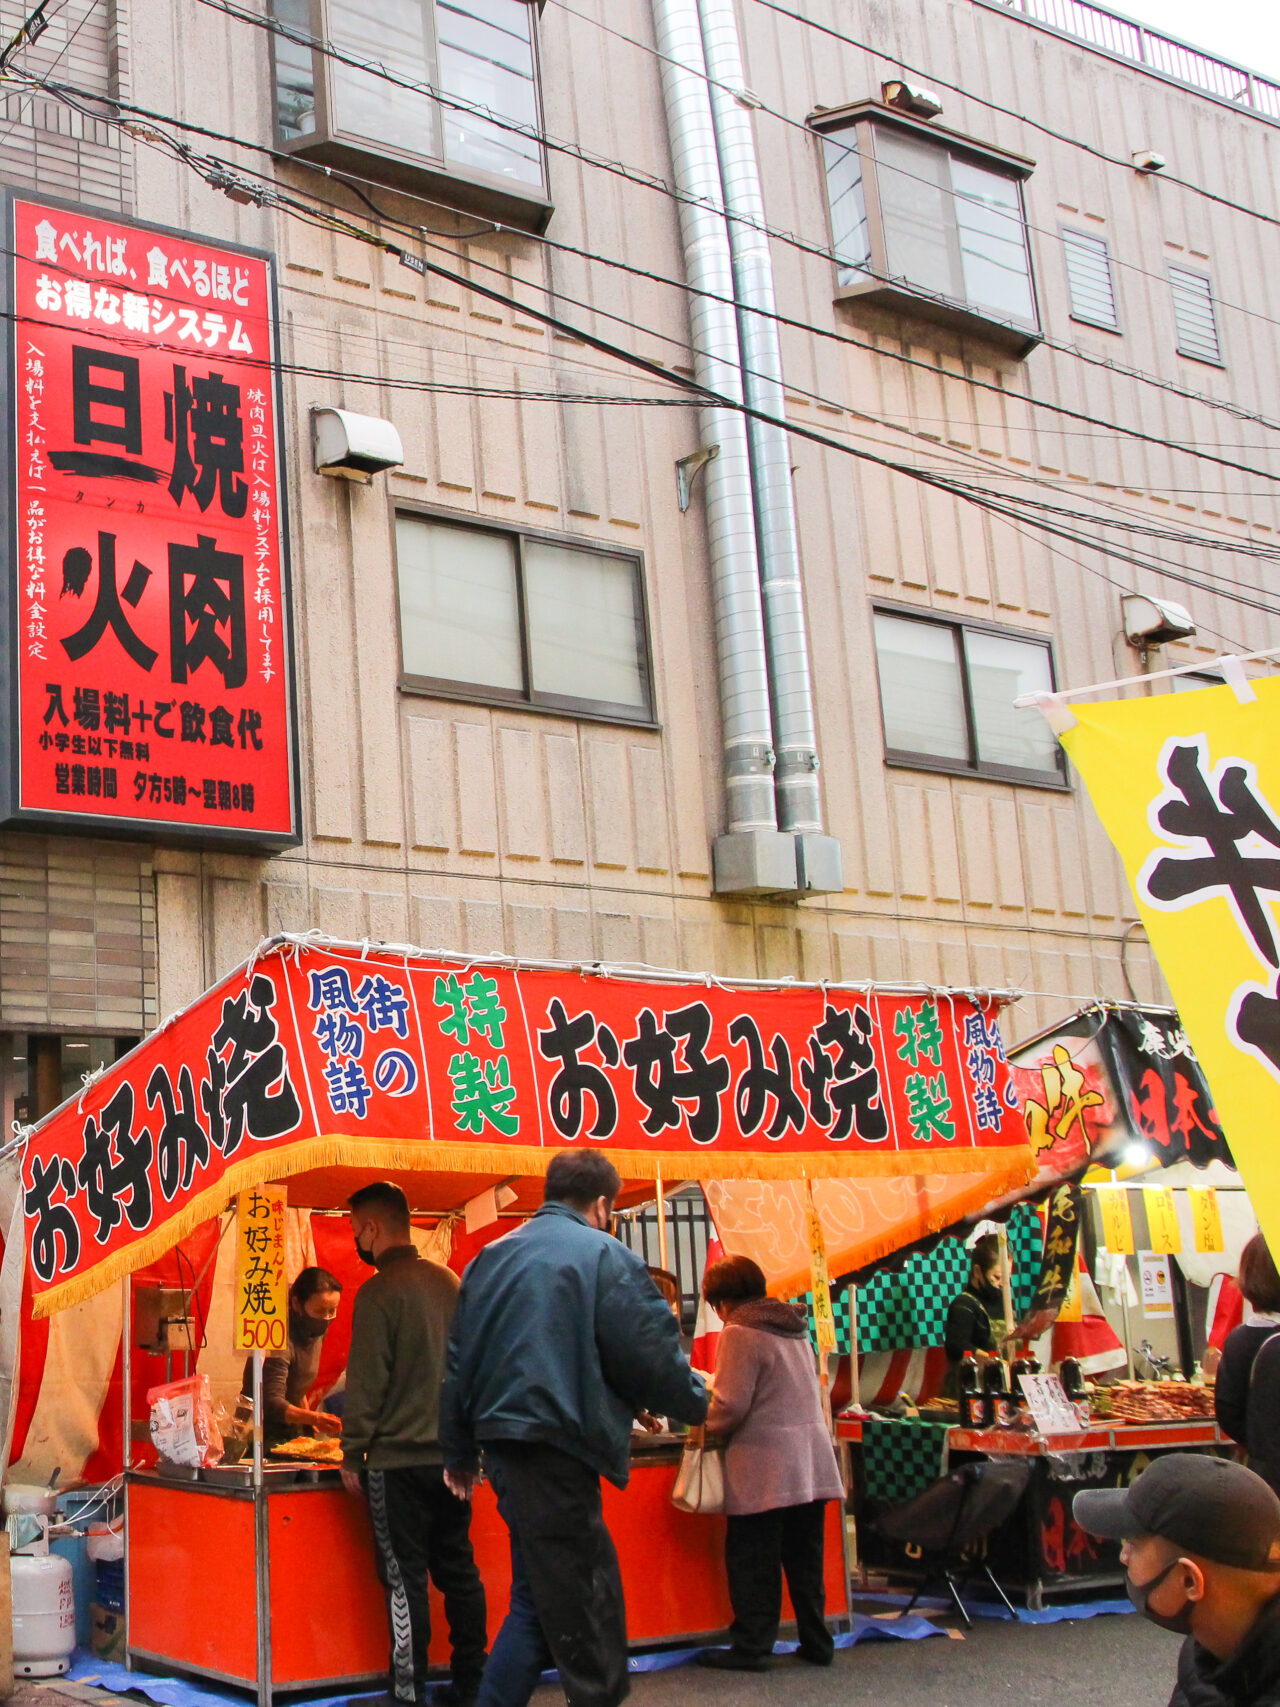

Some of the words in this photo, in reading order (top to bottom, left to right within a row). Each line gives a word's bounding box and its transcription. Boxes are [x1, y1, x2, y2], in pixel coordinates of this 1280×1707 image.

[35, 219, 250, 306] 食べれば、食べるほど
[35, 274, 253, 354] お得な新システム
[24, 340, 47, 660] 入場料を支払えば一品がお得な料金設定
[163, 363, 249, 689] 焼肉
[247, 388, 275, 684] 焼肉旦火は入場料システムを採用してます
[38, 731, 150, 762] 小学生以下無料
[55, 762, 118, 799] 営業時間
[307, 964, 373, 1121] 風物詩
[356, 973, 419, 1097] 街の
[433, 970, 520, 1138] 特製
[535, 996, 889, 1144] お好み焼
[892, 998, 956, 1142] 特製
[961, 1011, 1003, 1134] 風物詩
[23, 972, 302, 1283] お好み焼
[240, 1191, 277, 1316] お好み焼
[242, 1317, 286, 1349] 500
